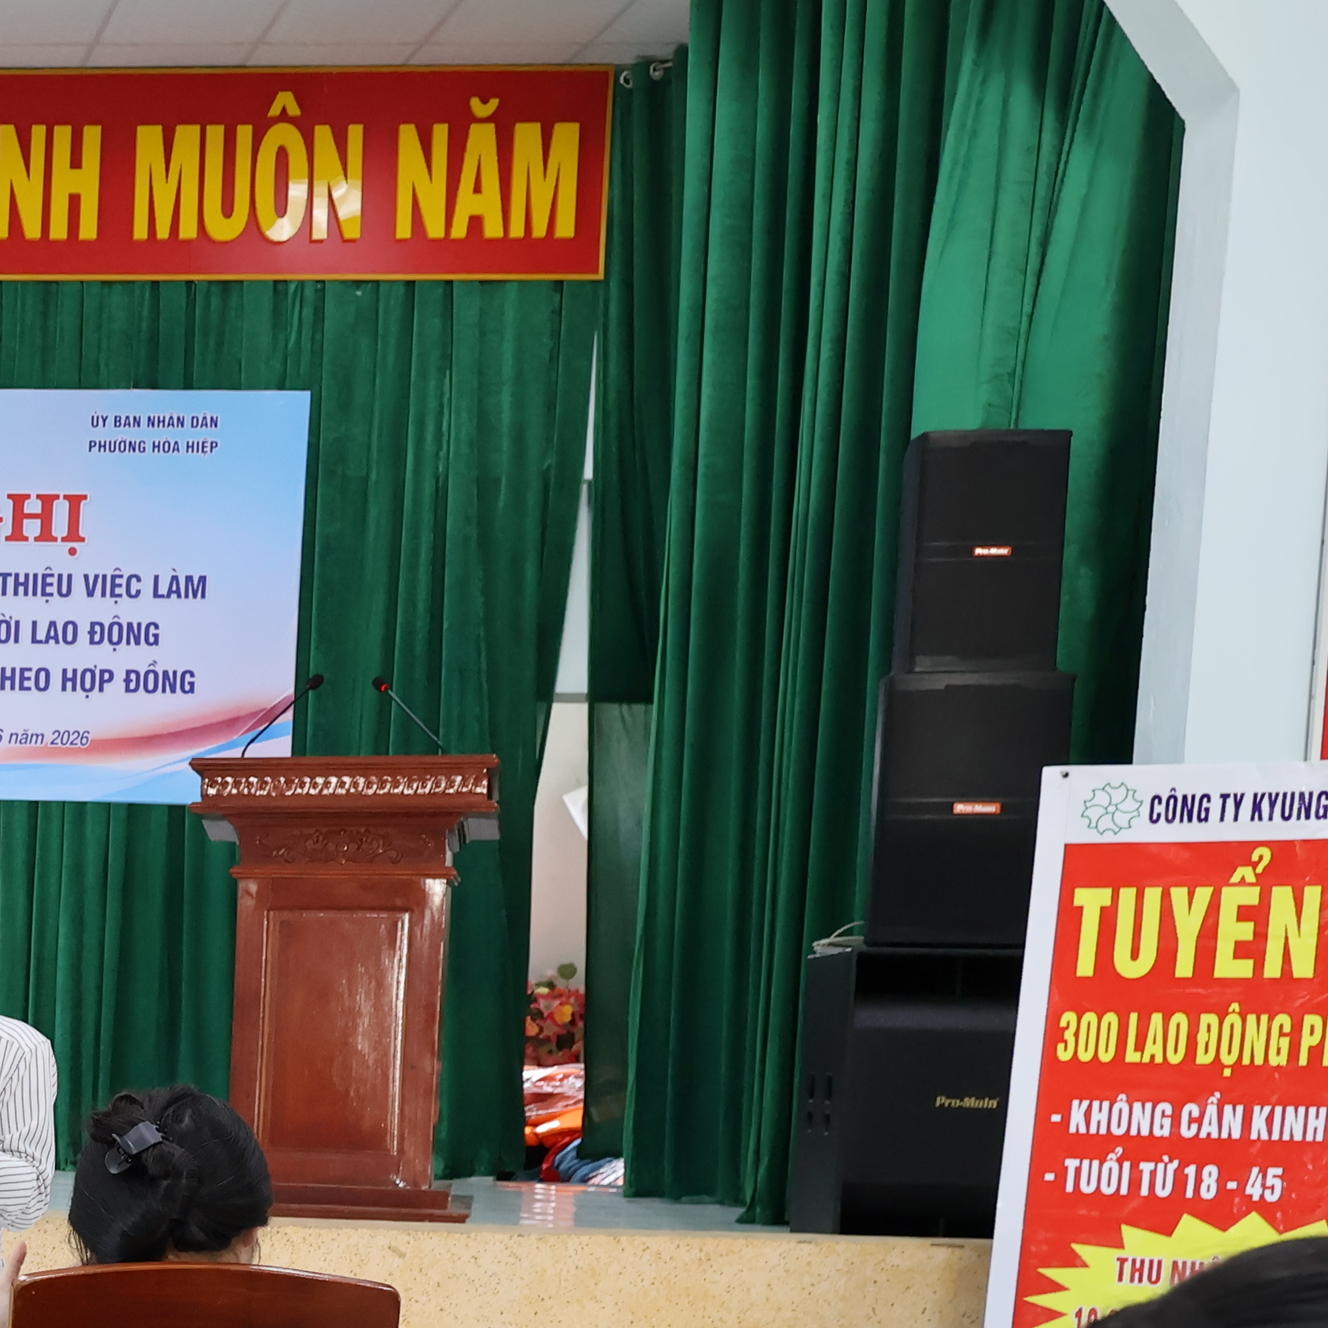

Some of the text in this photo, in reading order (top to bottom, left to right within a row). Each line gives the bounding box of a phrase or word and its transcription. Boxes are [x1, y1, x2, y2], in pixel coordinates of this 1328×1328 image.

[134, 92, 363, 241] MUÔN
[396, 98, 579, 239] NĂM
[91, 415, 218, 428] ỦY BAN NHÂN DÂN
[89, 440, 218, 454] PHƯỜNG HÒA HIỆP
[83, 568, 141, 604] VIỆC
[153, 568, 206, 599] LÀM
[31, 620, 78, 645] LAO
[88, 615, 159, 651] ĐỘNG
[61, 665, 114, 698] HỢP
[123, 660, 195, 694] ĐỒNG
[9, 729, 44, 744] năm
[49, 729, 91, 747] 2026
[1149, 788, 1211, 824] CÔNG
[1220, 793, 1245, 822] TY
[1074, 847, 1322, 978] TUYỂN
[1057, 1011, 1119, 1062] 300
[1125, 1012, 1188, 1064] LAO
[1196, 1003, 1291, 1076] ĐỘNG
[1069, 1092, 1326, 1141] KHÔNG CẦN KINH
[1065, 1147, 1130, 1195] TUỔI
[1139, 1156, 1179, 1198] TỪ
[1184, 1163, 1219, 1200] 18
[1245, 1167, 1284, 1202] 45
[1117, 1257, 1162, 1285] THU
